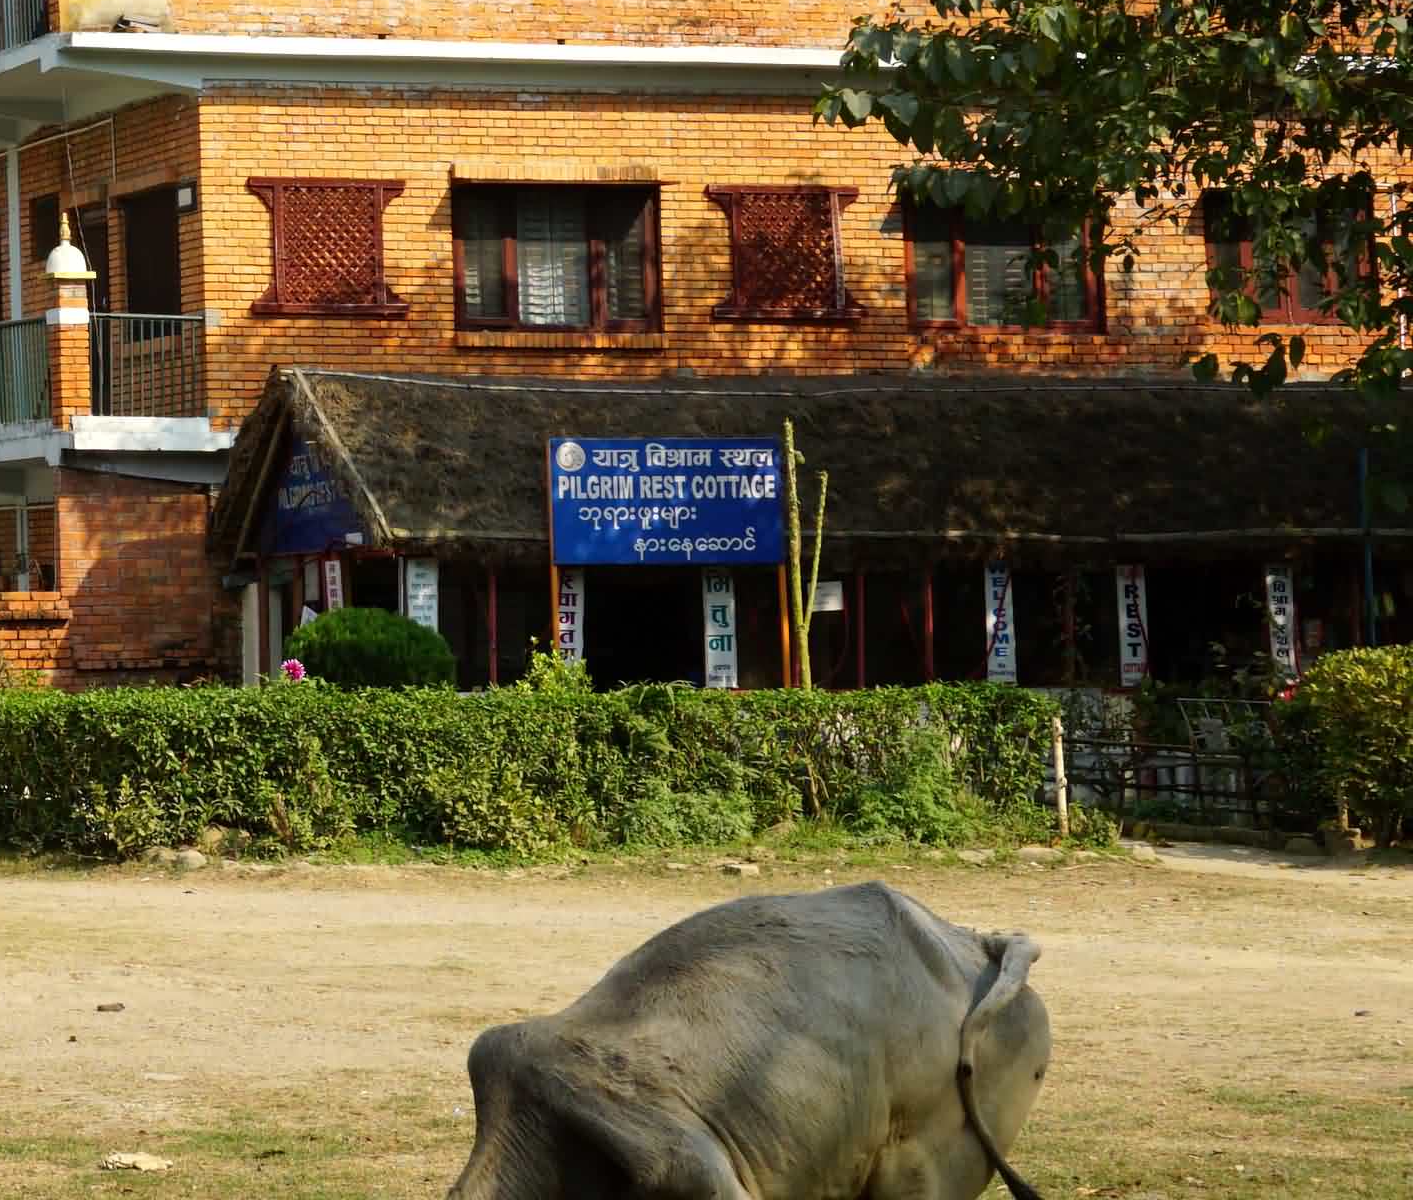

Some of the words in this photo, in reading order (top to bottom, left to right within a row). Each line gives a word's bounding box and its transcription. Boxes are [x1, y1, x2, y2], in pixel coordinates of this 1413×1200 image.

[645, 443, 712, 468] विश्राम
[719, 448, 773, 468] स्थल
[558, 475, 633, 499] PILGRIM
[640, 475, 685, 499] REST
[692, 475, 776, 499] COTTAGE
